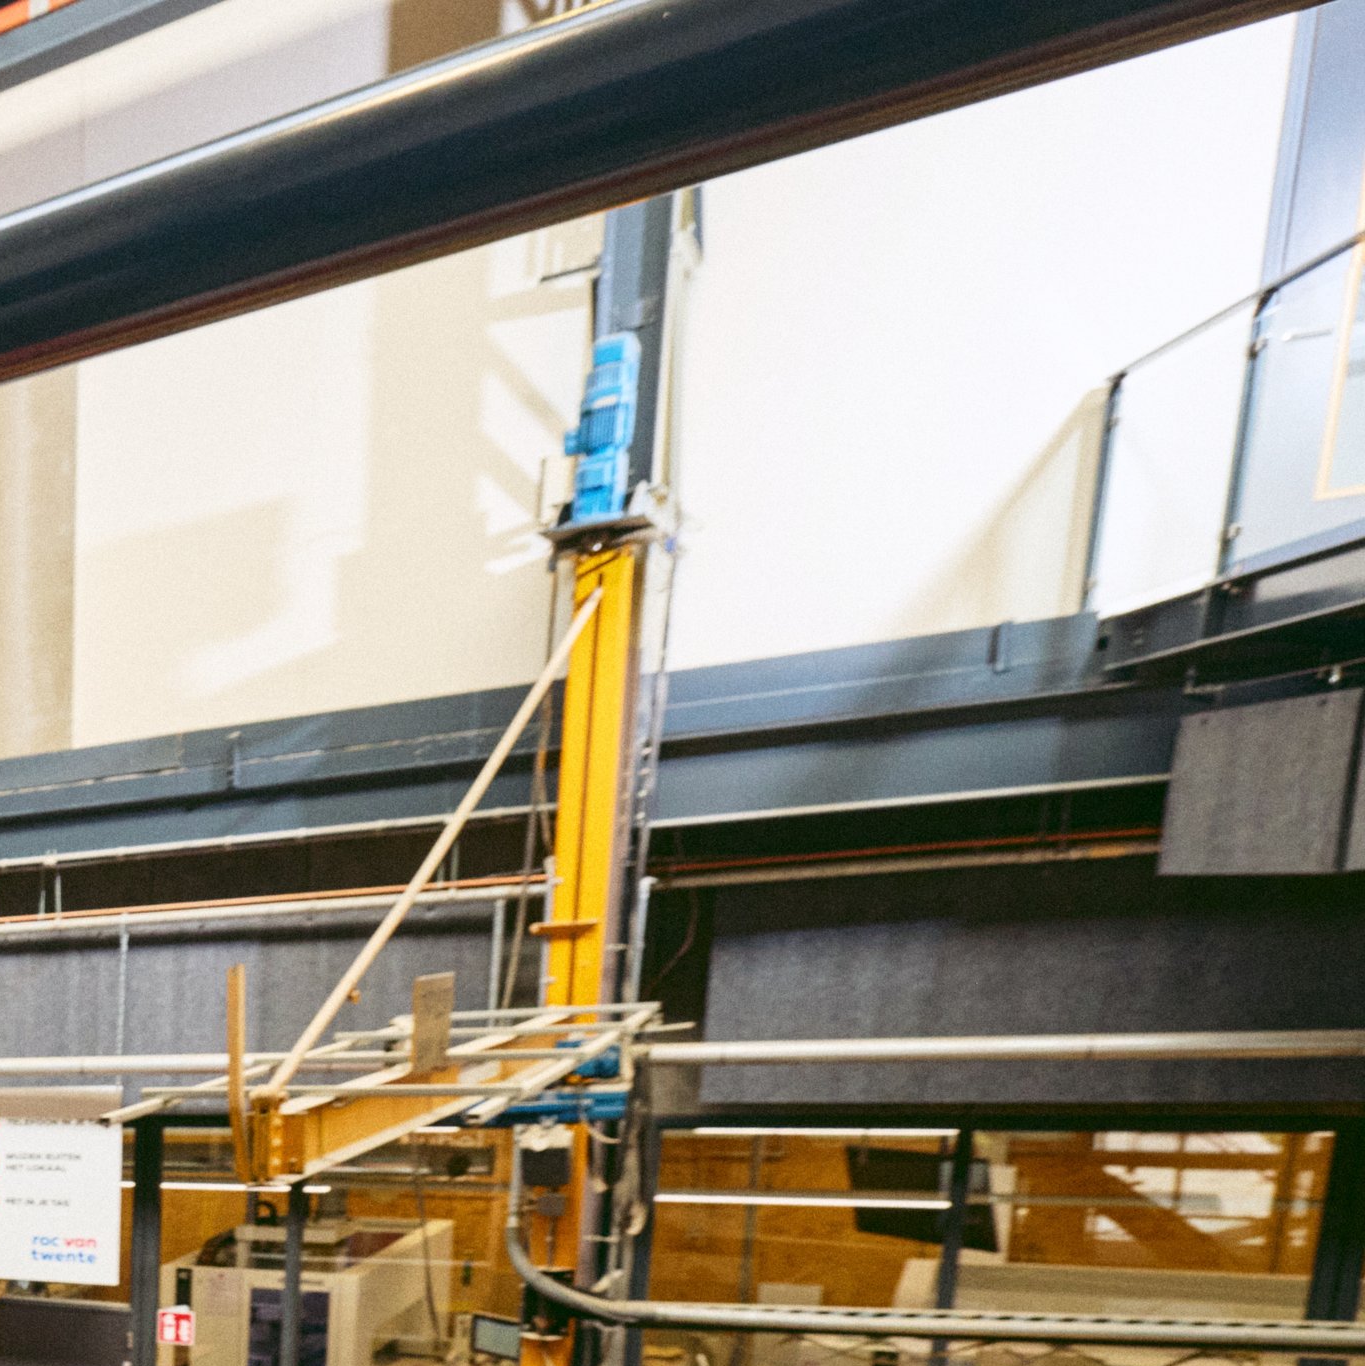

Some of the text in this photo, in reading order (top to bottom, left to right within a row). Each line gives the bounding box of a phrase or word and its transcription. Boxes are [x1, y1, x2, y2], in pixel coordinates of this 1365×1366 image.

[32, 1235, 97, 1248] roc van
[31, 1249, 97, 1264] twente
